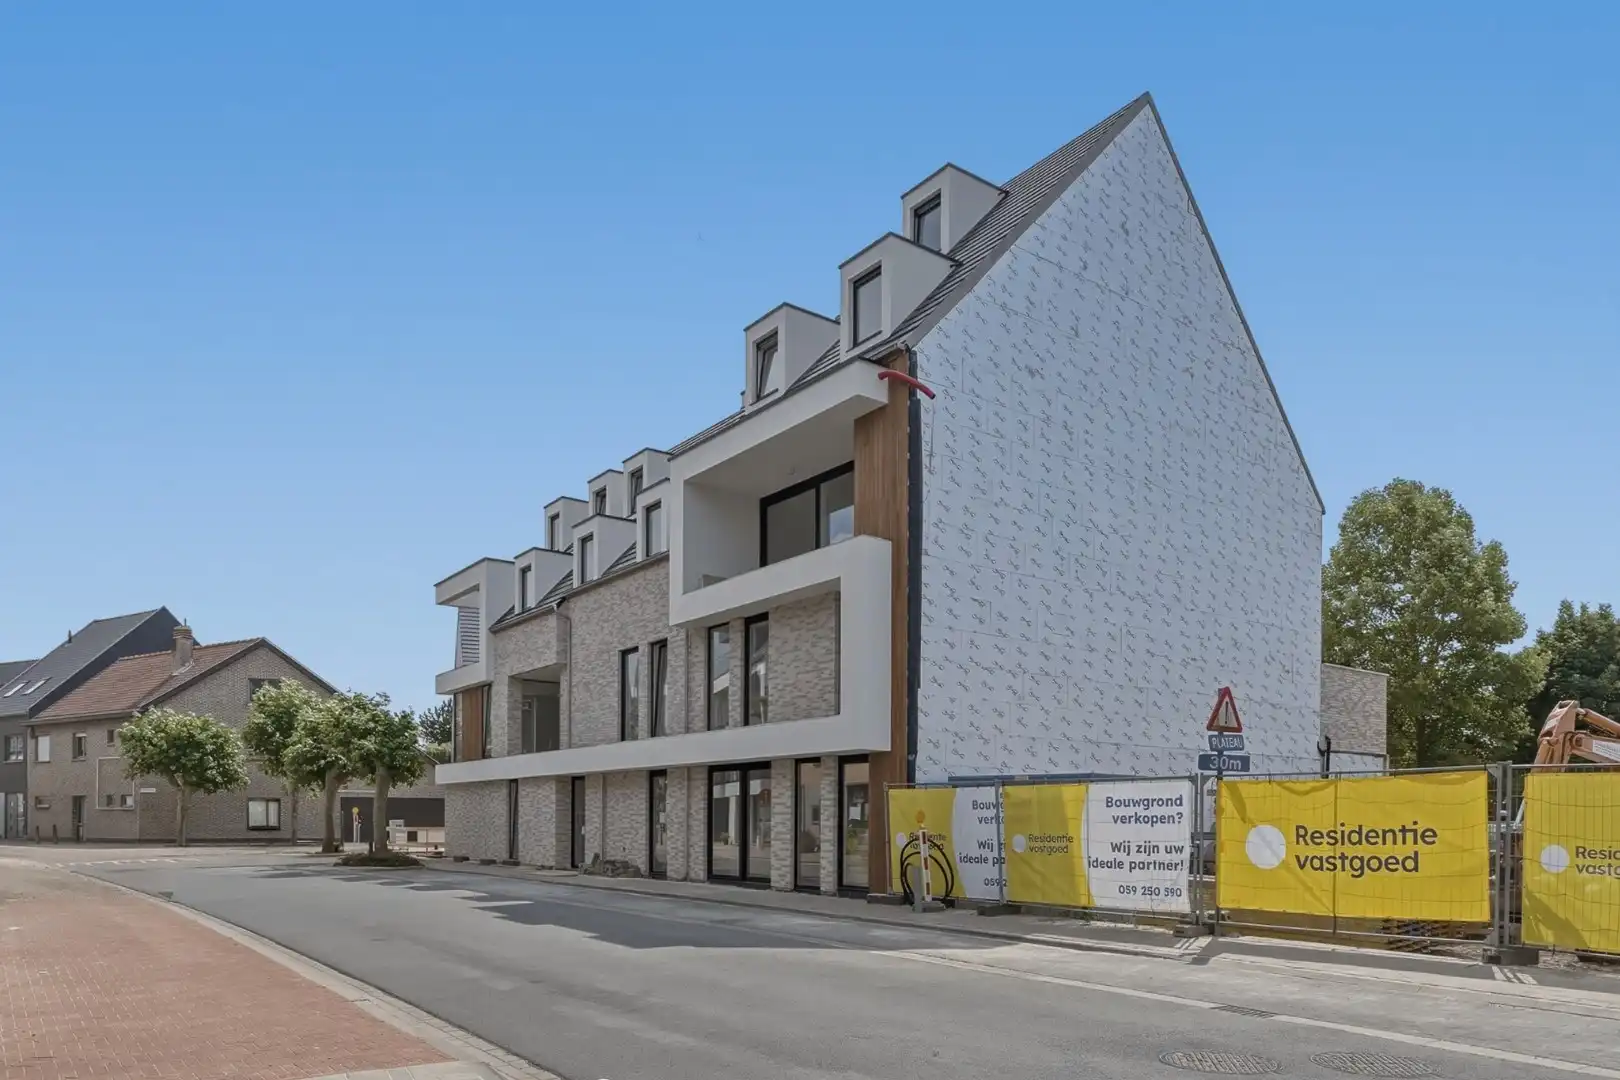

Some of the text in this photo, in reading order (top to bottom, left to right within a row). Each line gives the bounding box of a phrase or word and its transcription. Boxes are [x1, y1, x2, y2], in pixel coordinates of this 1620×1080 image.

[1211, 736, 1243, 749] PLATEAU
[1209, 756, 1242, 770] 30m
[1105, 794, 1184, 811] Bouwgrond
[1112, 811, 1184, 828] verkopen?
[1028, 832, 1074, 844] Residentie
[1295, 820, 1438, 847] Residentie
[977, 838, 993, 852] Wij
[1028, 844, 1069, 856] vastgoed
[1110, 840, 1184, 856] Wij zijn uw
[959, 852, 989, 865] ideale
[1088, 856, 1184, 873] ideale partner!
[1294, 850, 1419, 878] vastgoed
[1118, 884, 1183, 897] 059 250 590
